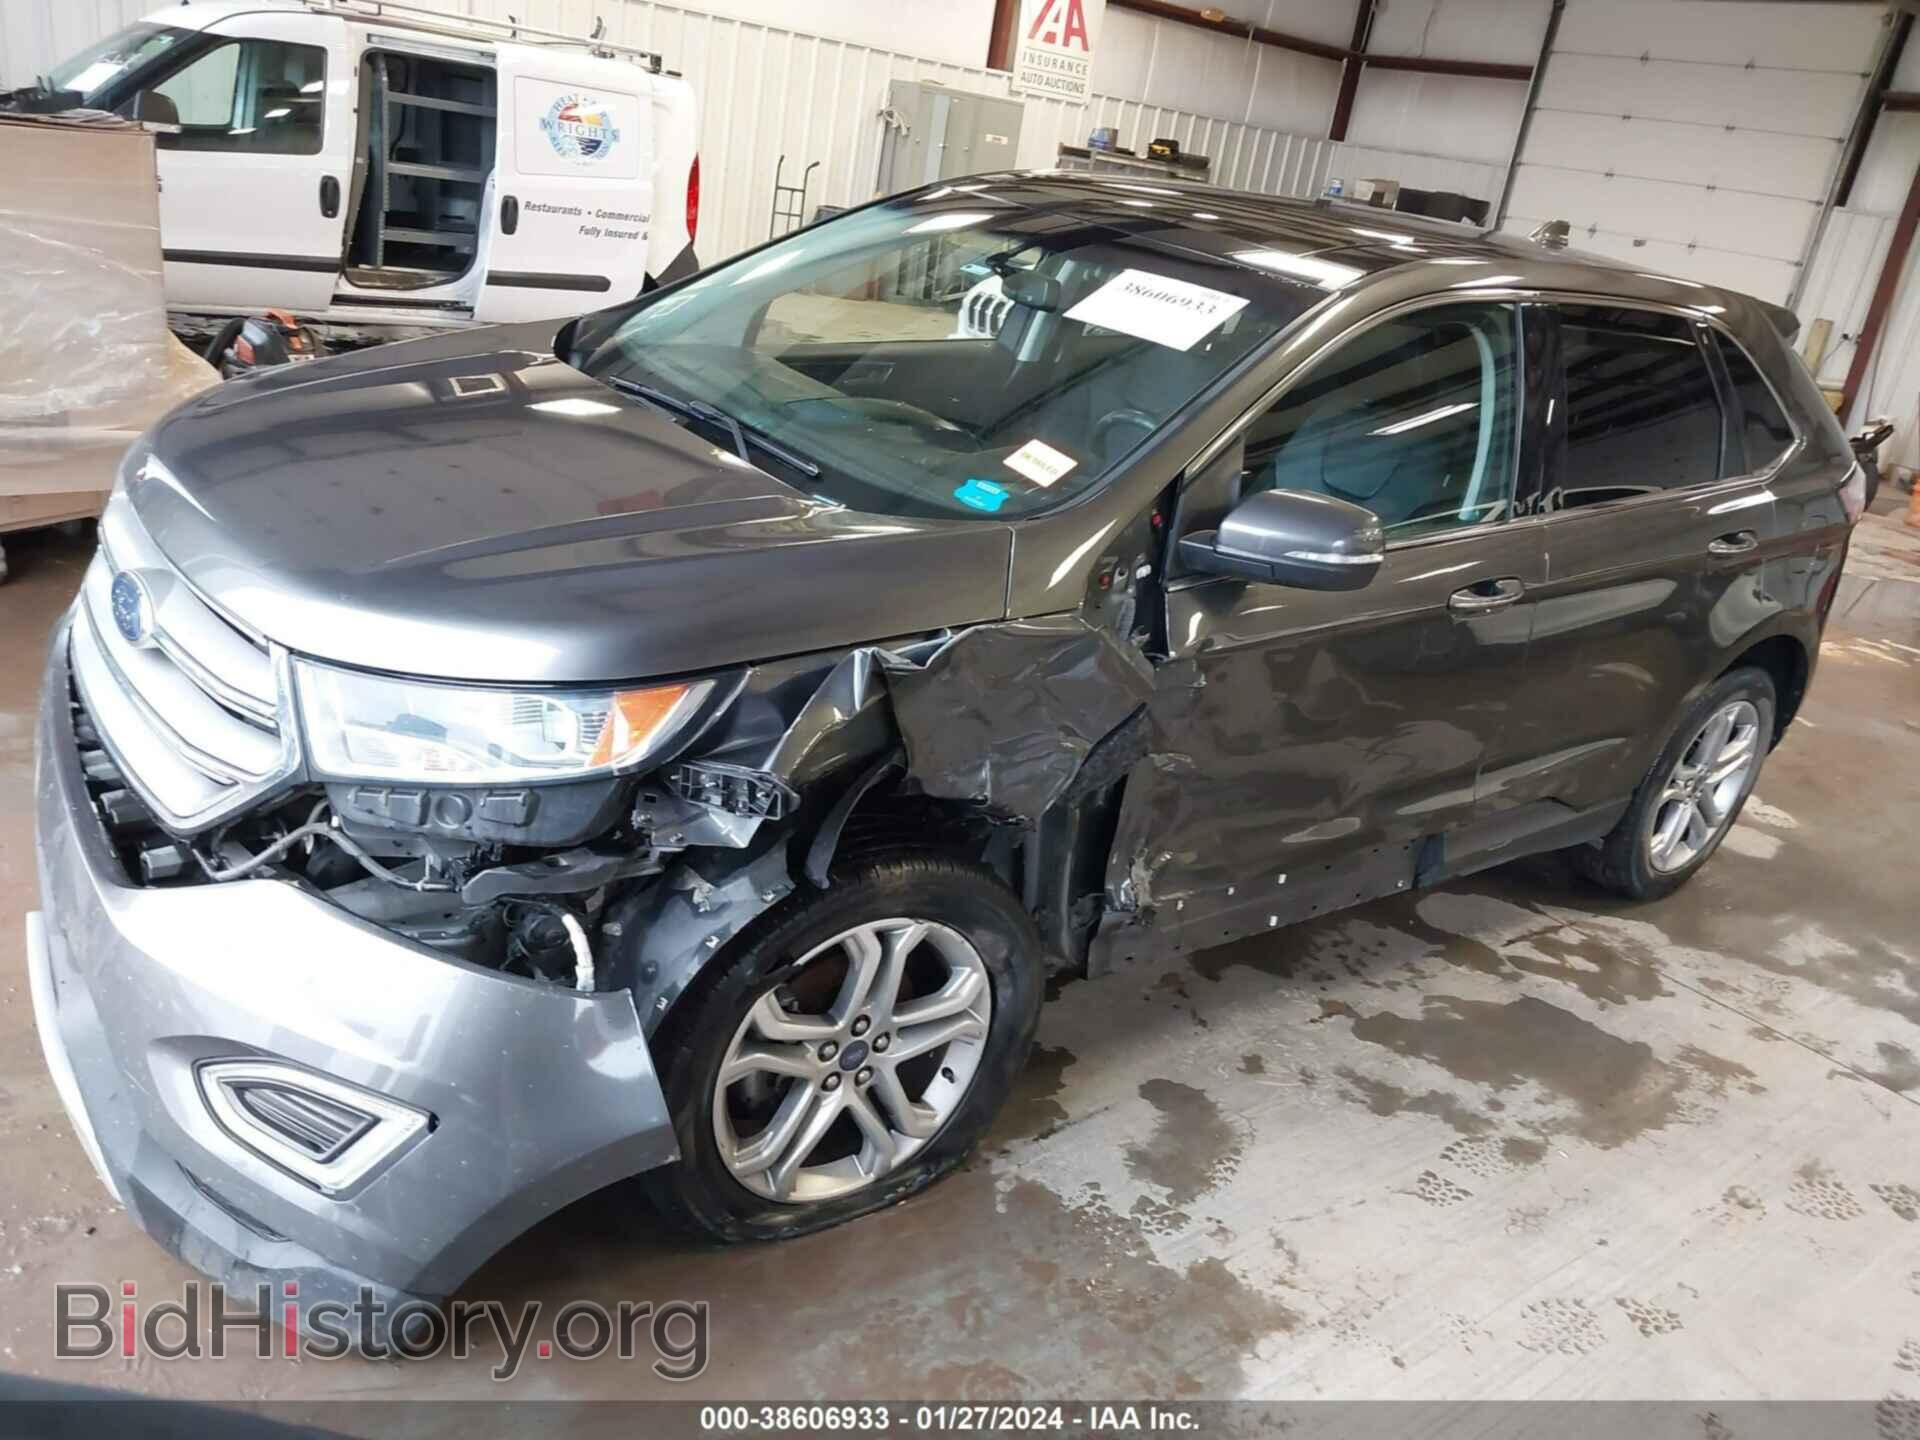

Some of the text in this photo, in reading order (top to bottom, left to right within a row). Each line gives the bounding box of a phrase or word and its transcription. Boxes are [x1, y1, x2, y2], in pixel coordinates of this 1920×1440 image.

[1022, 52, 1088, 75] INSURANCE
[1020, 72, 1086, 94] AUTO AUCTIONS
[539, 118, 620, 142] WRIGHTS
[524, 200, 651, 223] Restaurants Commercial
[578, 225, 649, 240] Fully Insured &
